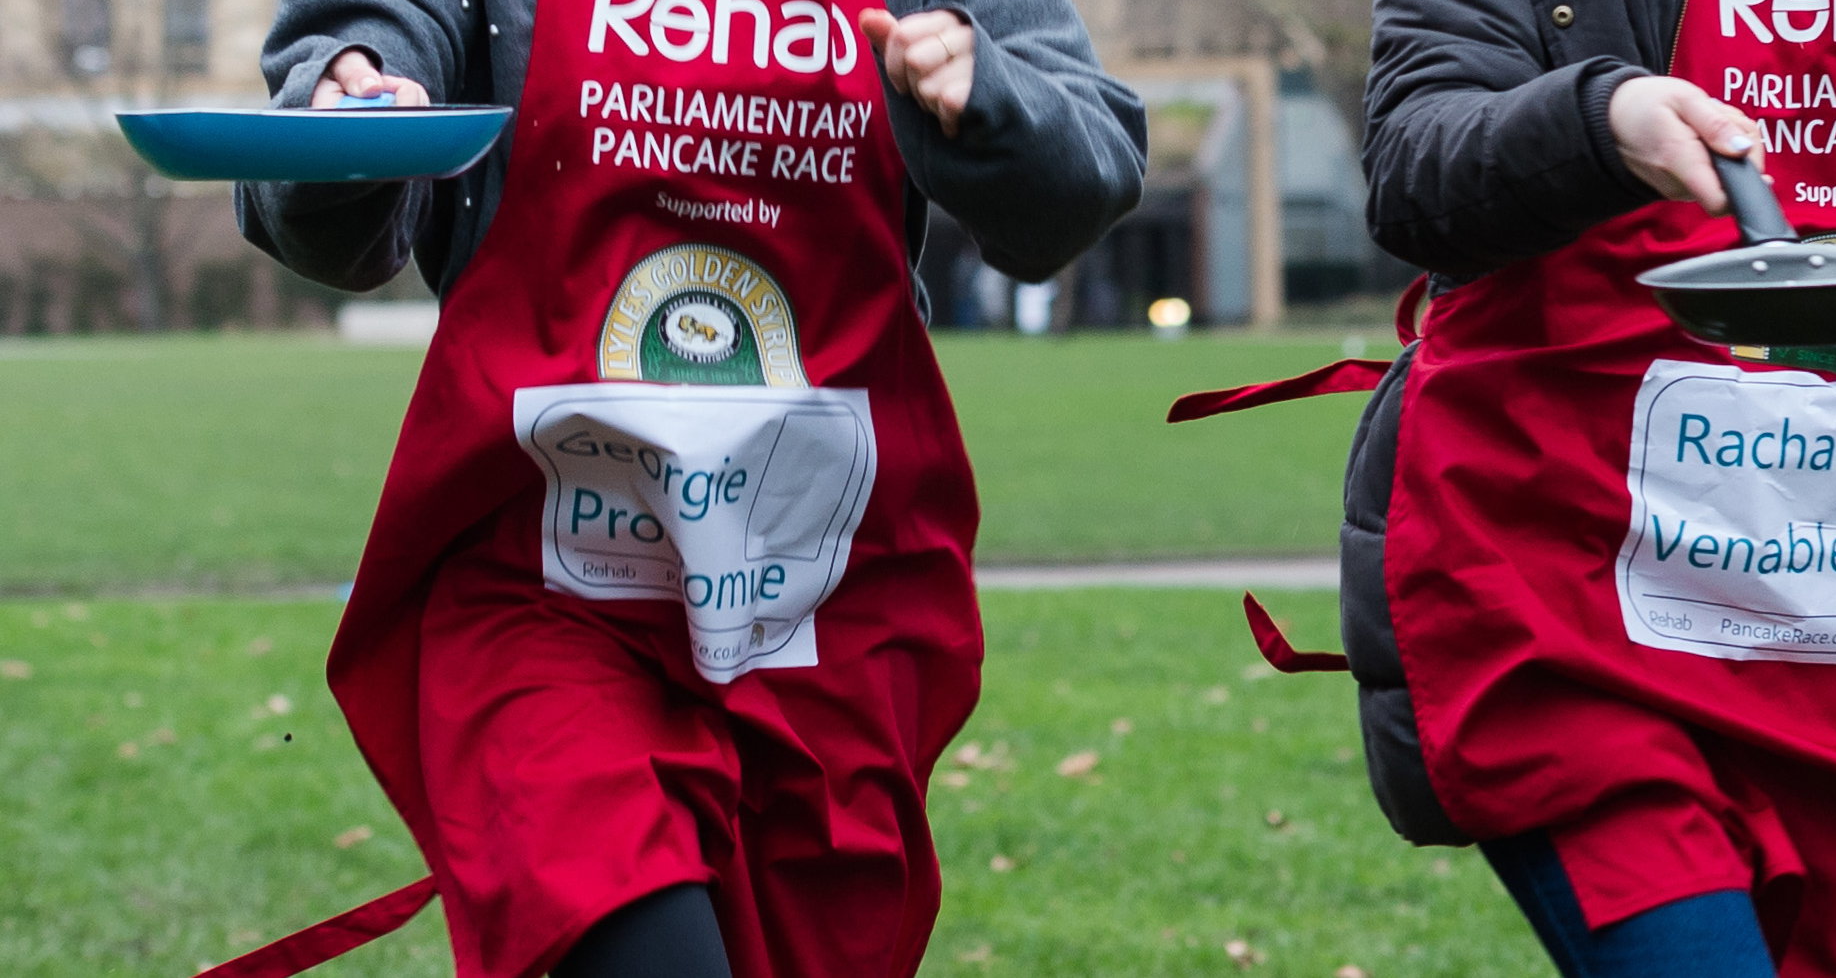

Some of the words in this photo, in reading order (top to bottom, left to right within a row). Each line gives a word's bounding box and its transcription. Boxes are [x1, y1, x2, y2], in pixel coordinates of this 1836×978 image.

[579, 79, 872, 139] PARLIAMENTARY
[592, 126, 762, 177] PANCAKE
[771, 143, 856, 184] RACE
[656, 190, 754, 224] Supported
[758, 198, 782, 228] by
[651, 252, 760, 301] GOLDEN
[555, 430, 748, 522] Georgie
[582, 561, 637, 580] Rehab
[1649, 611, 1693, 631] Rehab
